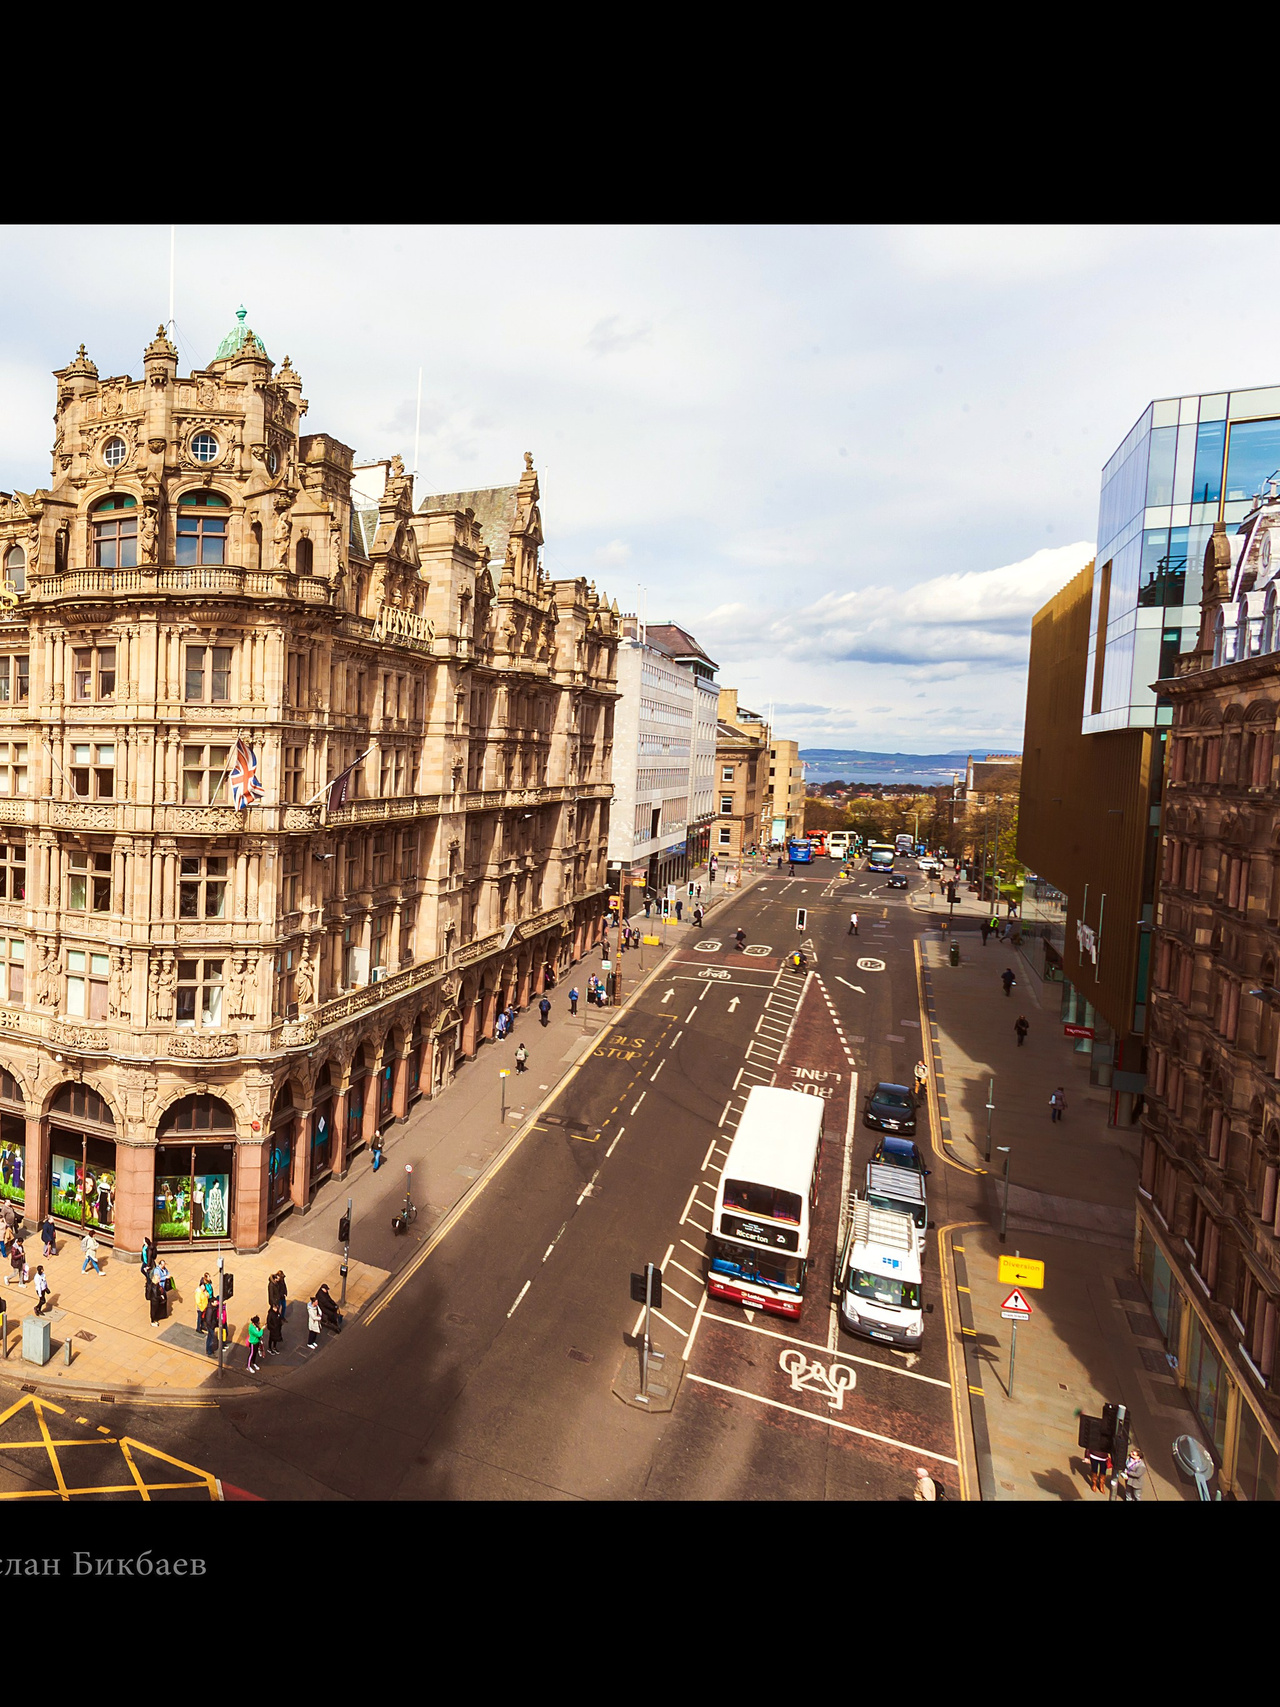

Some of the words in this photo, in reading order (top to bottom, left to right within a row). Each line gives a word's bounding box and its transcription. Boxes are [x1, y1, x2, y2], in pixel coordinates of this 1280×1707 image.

[376, 604, 436, 643] JENNERS
[608, 1034, 646, 1048] BUS
[593, 1046, 642, 1061] STOP
[790, 1066, 841, 1084] LANE
[790, 1081, 834, 1099] BUS
[1002, 1259, 1041, 1271] Diversion
